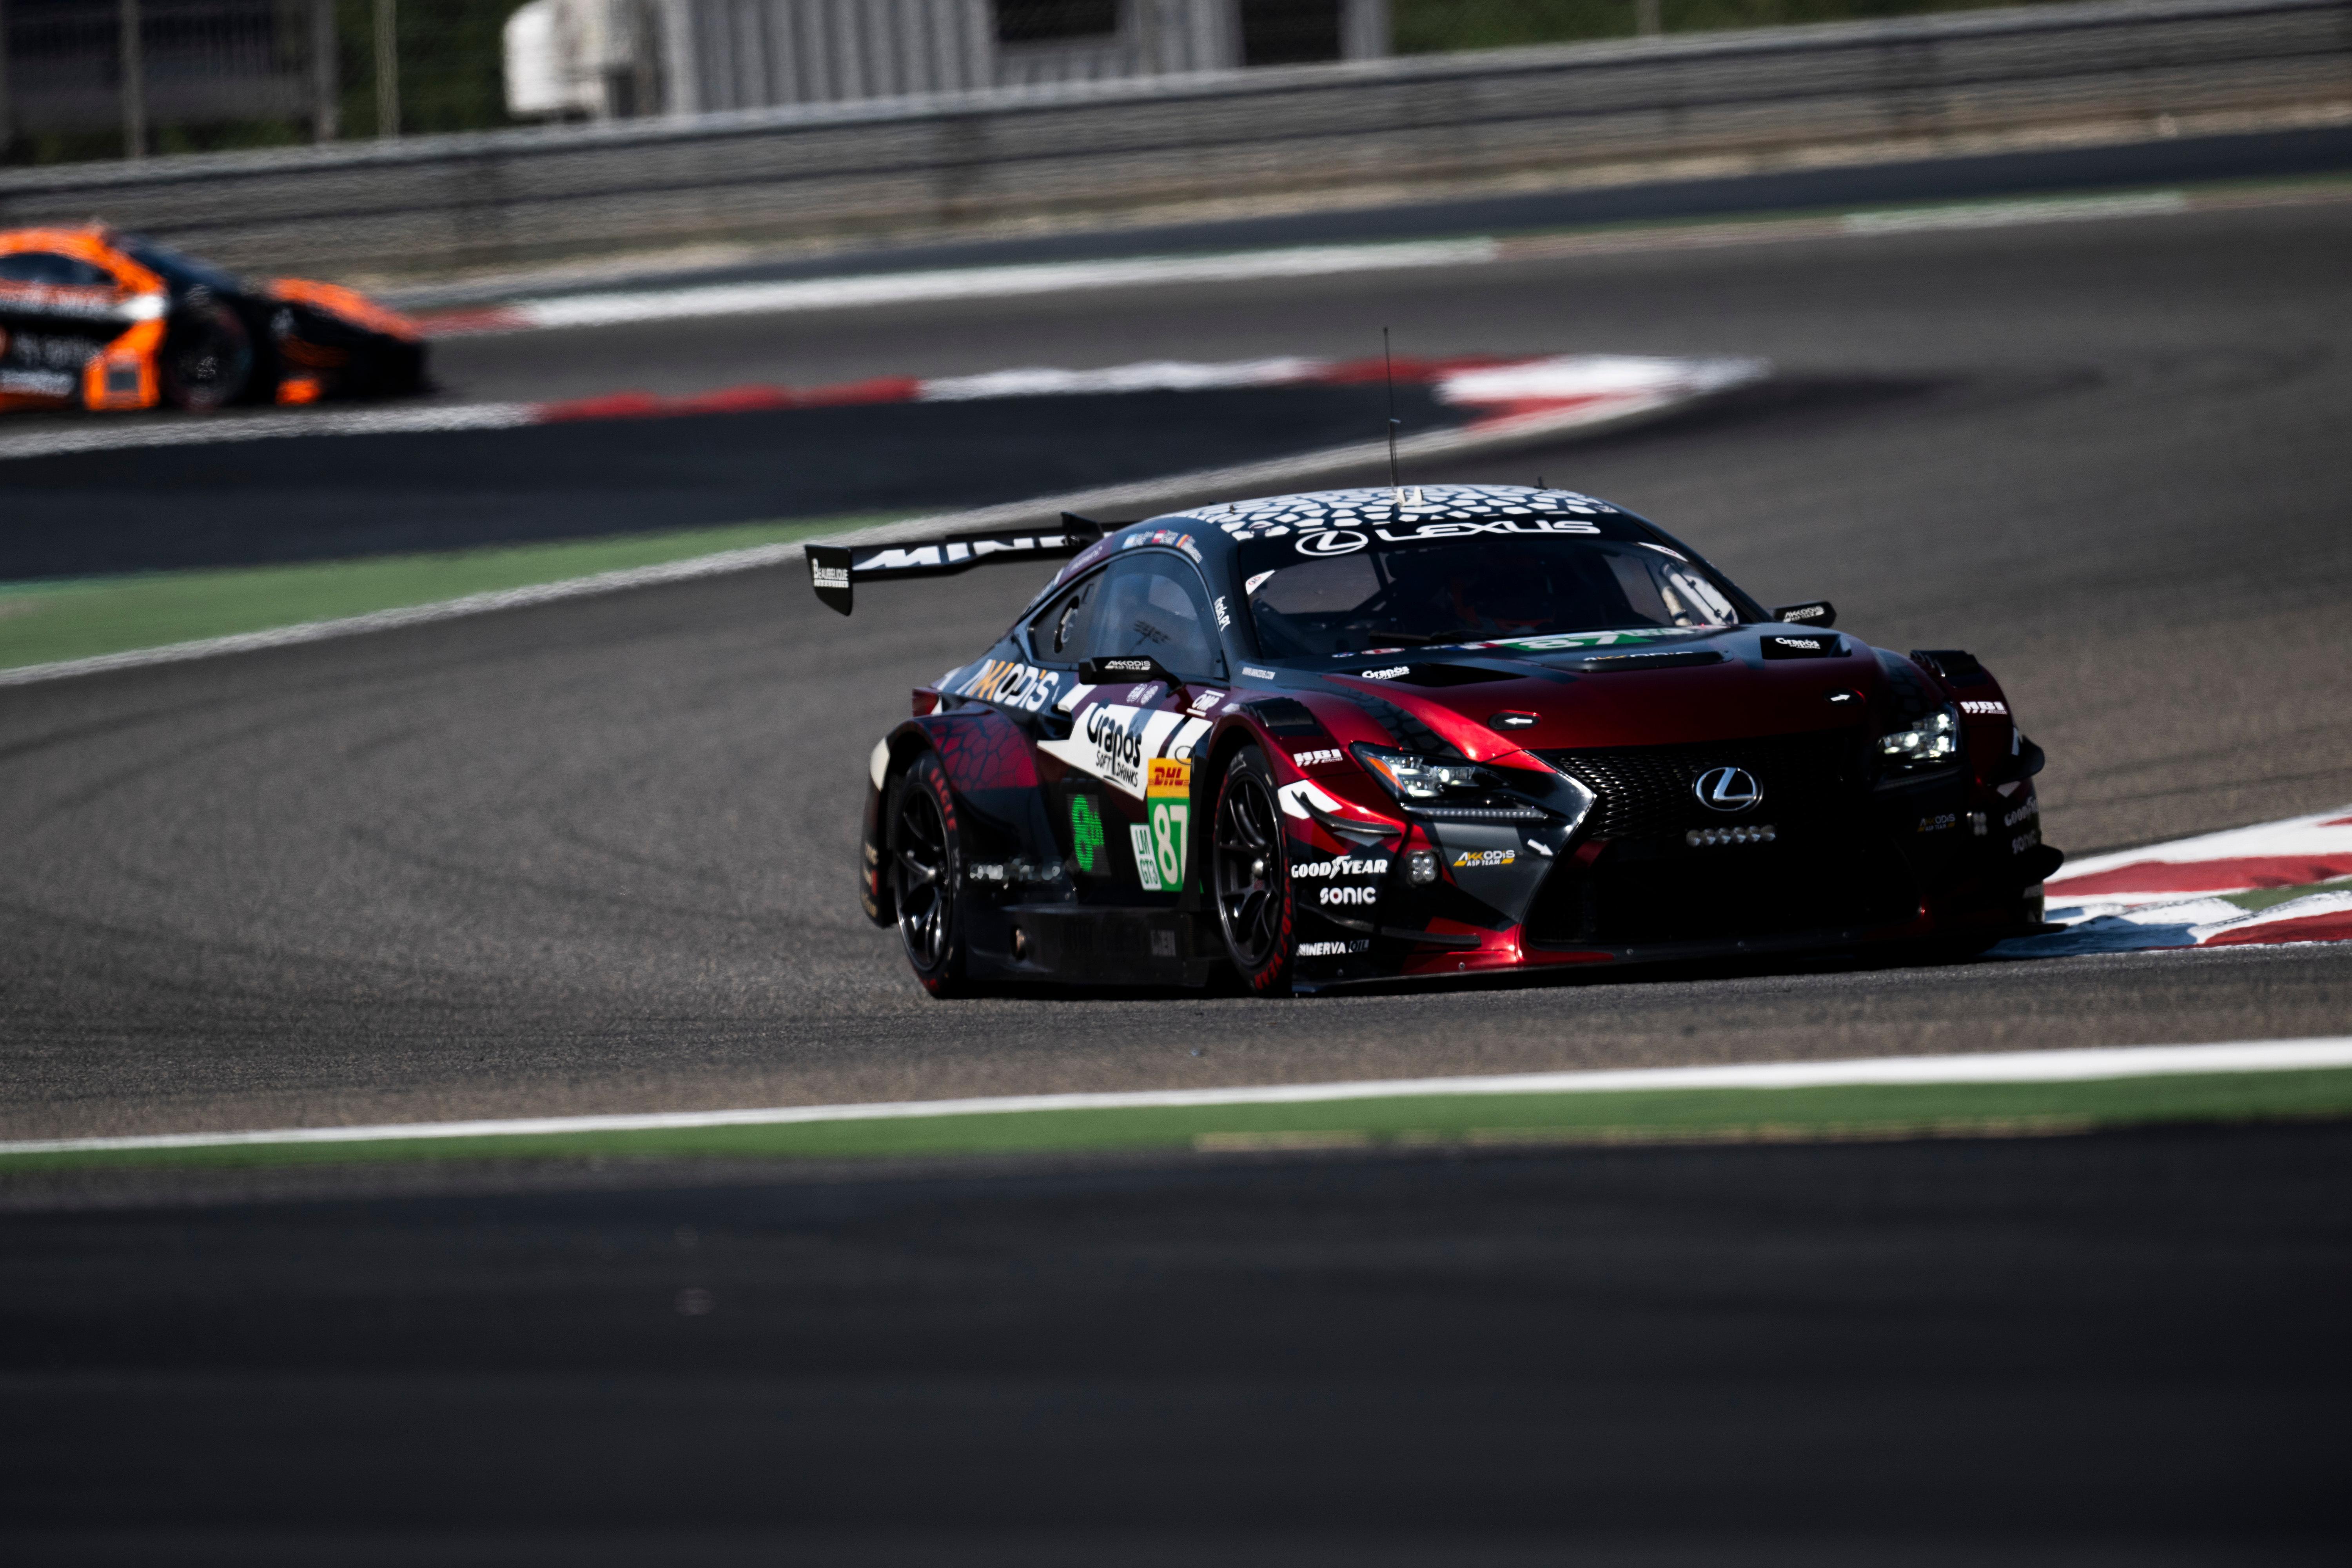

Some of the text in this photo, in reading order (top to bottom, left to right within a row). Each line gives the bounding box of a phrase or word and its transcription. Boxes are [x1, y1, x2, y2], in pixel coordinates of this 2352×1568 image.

[1374, 520, 1601, 541] LEXUS
[1518, 634, 1620, 650] 87
[1362, 666, 1410, 679] Grapos
[1960, 701, 2005, 711] HBI
[1087, 705, 1142, 775] Grapos
[1293, 748, 1342, 763] HBI
[1095, 750, 1139, 788] SOFT DRINKS
[1154, 766, 1184, 786] DHL
[1135, 829, 1151, 855] LM
[1153, 803, 1188, 885] 87
[1140, 858, 1158, 884] GT3
[1291, 855, 1388, 879] GOODYEAR
[1296, 941, 1346, 956] MINERVA
